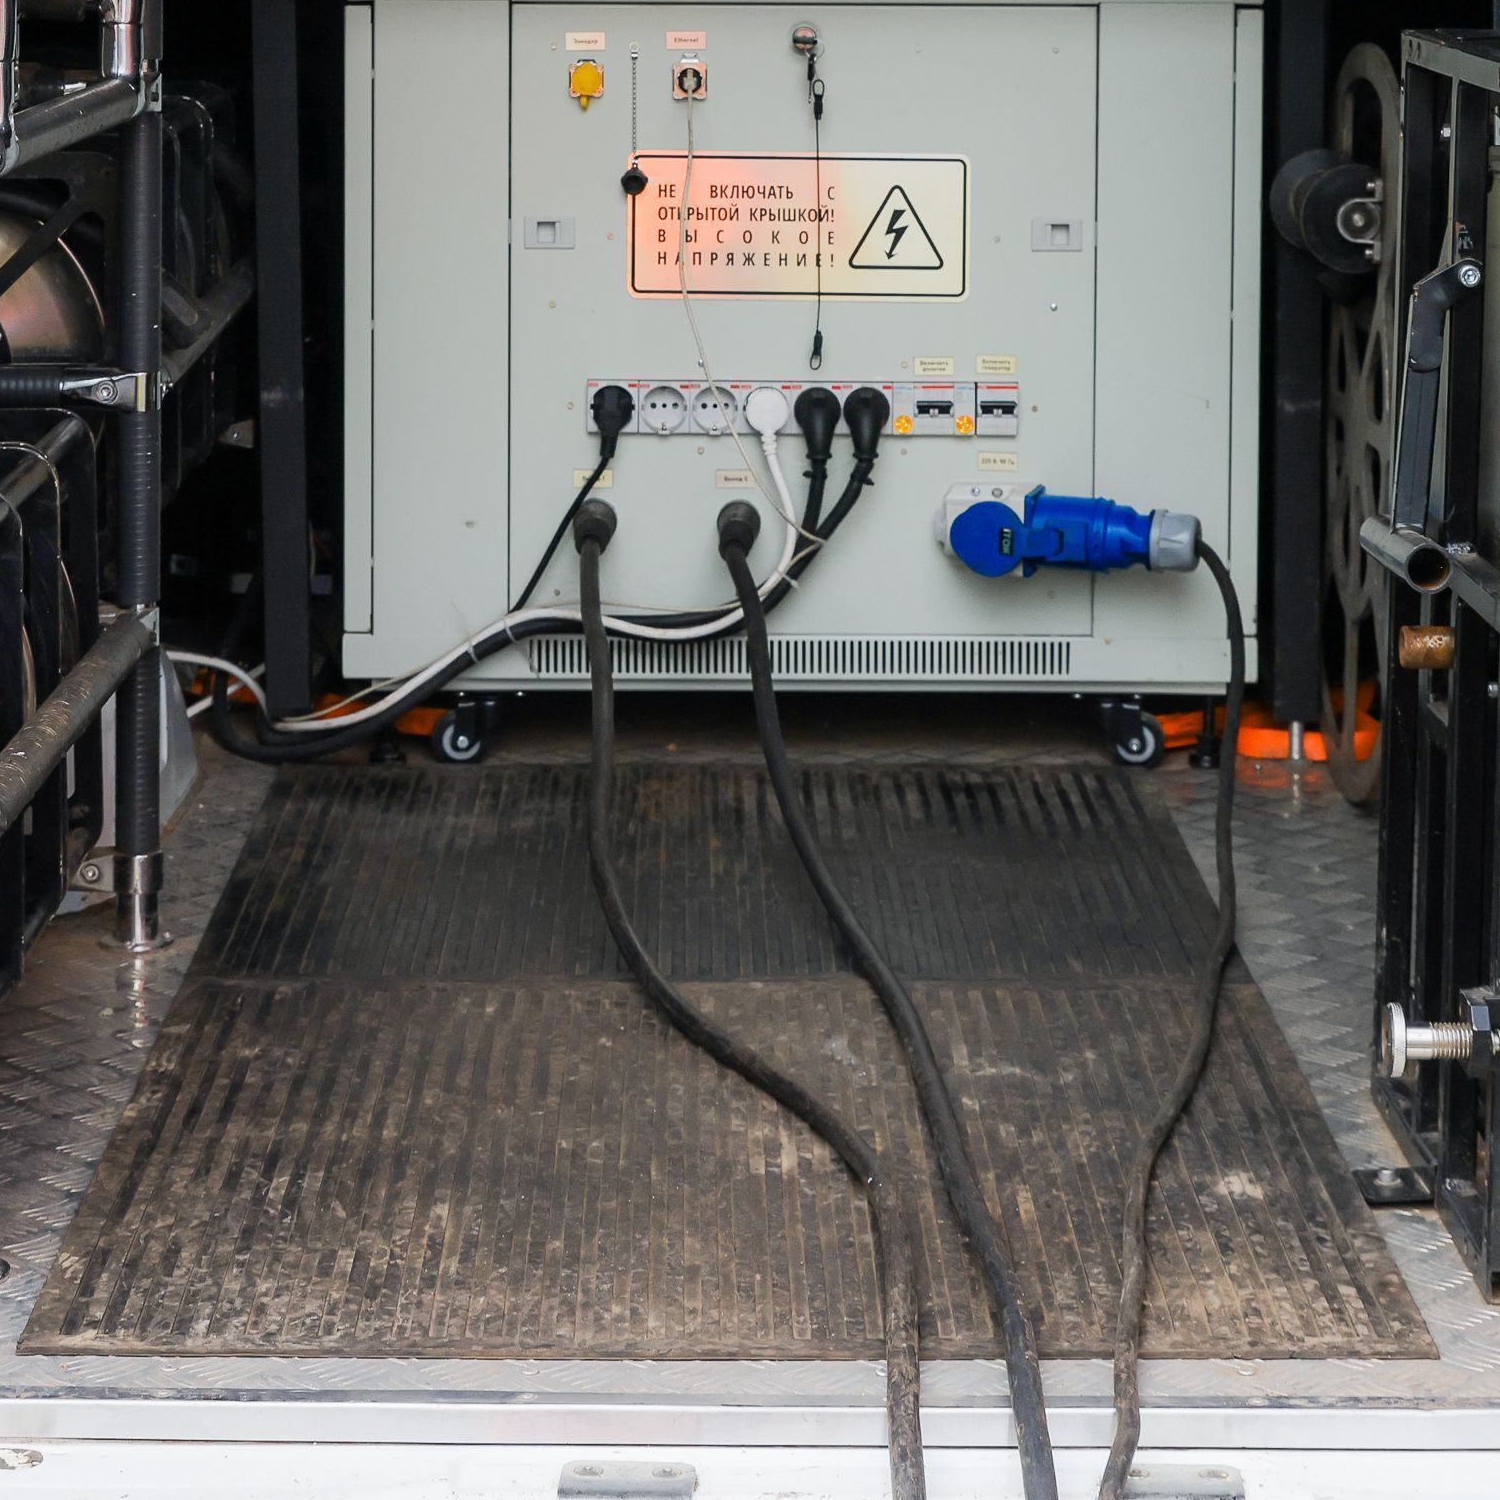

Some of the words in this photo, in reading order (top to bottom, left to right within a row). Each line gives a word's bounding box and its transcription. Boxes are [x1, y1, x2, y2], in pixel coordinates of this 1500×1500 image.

[658, 184, 676, 198] НЕ
[710, 185, 794, 200] ВКЛЮЧАТЬ
[827, 186, 835, 200] С
[750, 205, 834, 223] КРЫШКОЙ!
